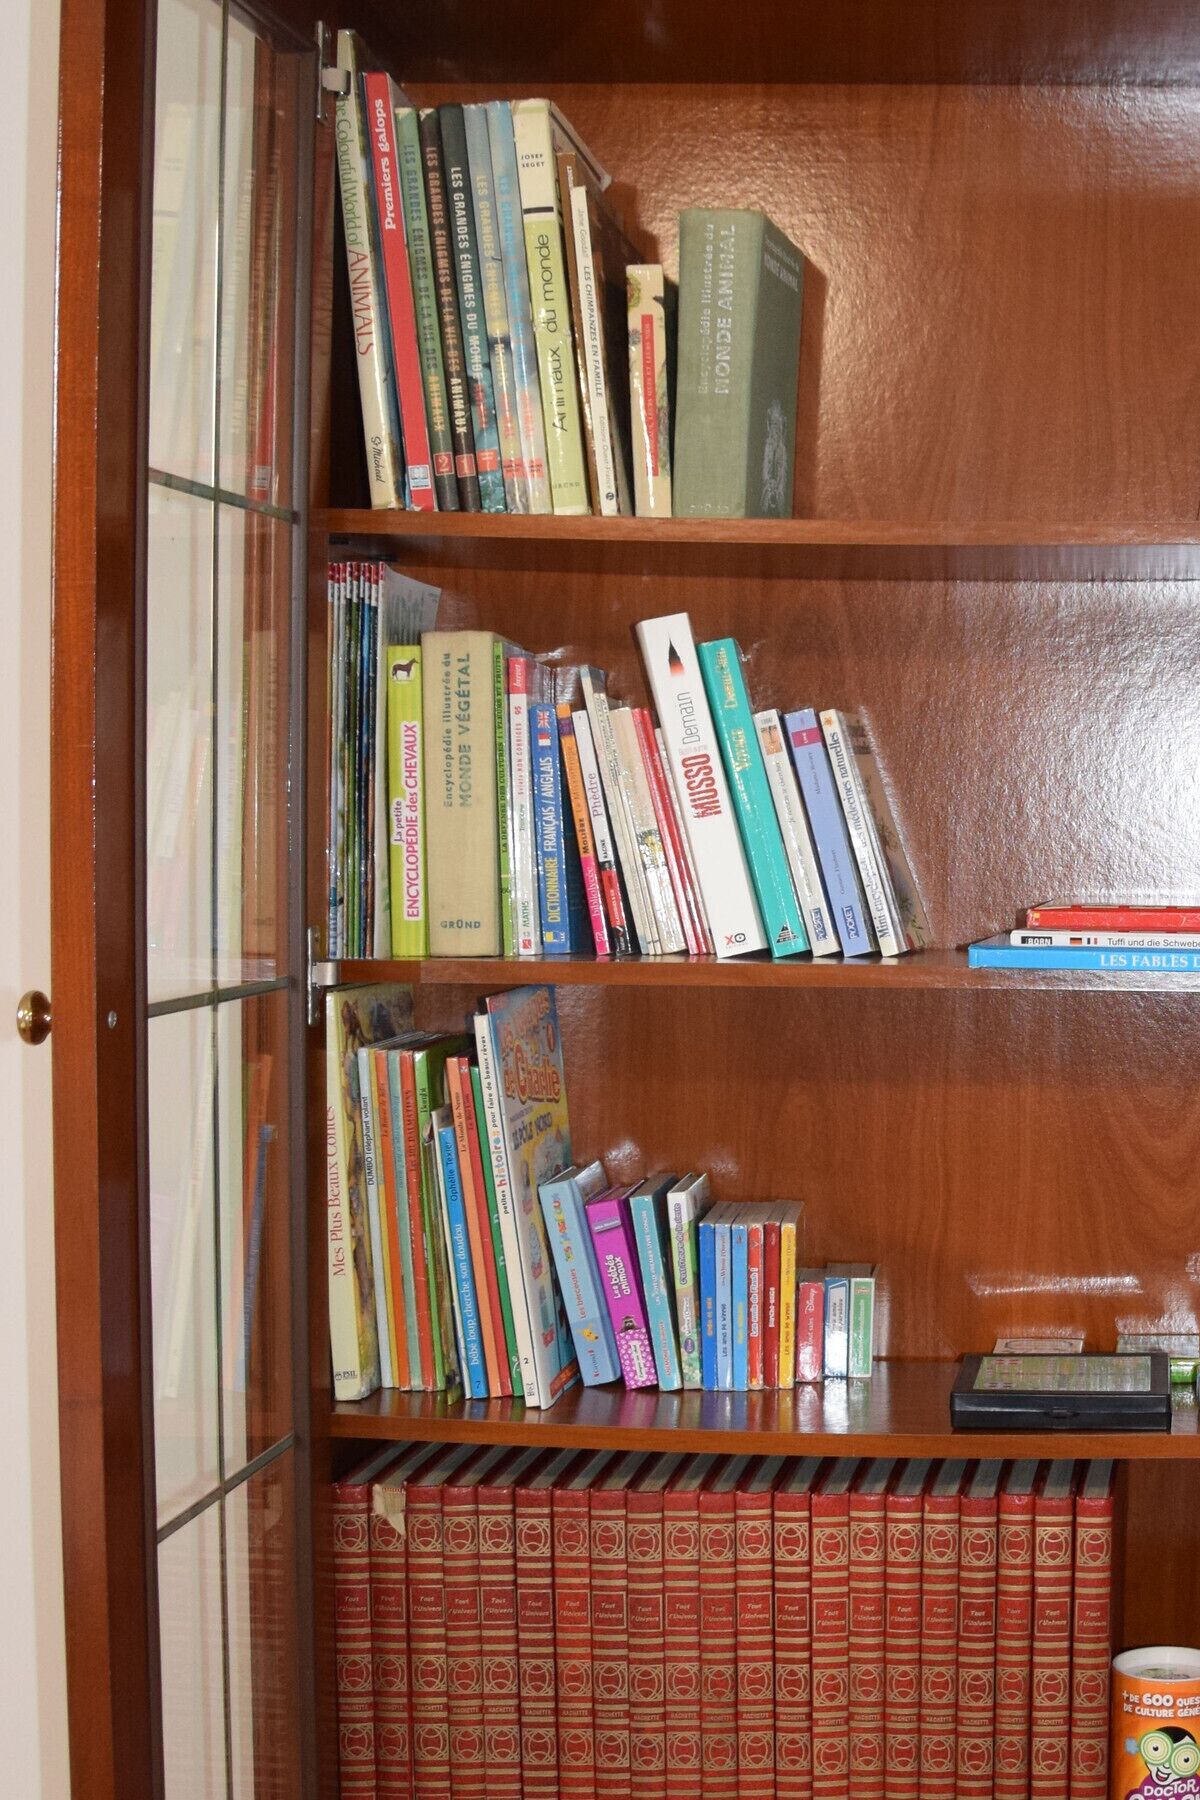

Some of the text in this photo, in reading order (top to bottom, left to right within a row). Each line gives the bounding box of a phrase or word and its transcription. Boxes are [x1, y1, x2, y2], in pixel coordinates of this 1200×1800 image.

[374, 98, 397, 230] Premiers galops
[449, 167, 464, 188] LES
[337, 120, 374, 356] Colourful World of ANIMALS
[452, 192, 471, 249] GRANDES
[704, 224, 715, 245] du
[536, 233, 554, 304] monde
[465, 313, 480, 330] DU
[545, 310, 558, 333] du
[582, 265, 592, 282] LES
[592, 356, 604, 398] FAMILLE
[714, 224, 736, 395] MONDE ANIMAL
[429, 375, 446, 432] ANIMAUX
[450, 378, 468, 434] ANIMAUX
[442, 652, 454, 808] Encyclopédie du
[453, 652, 472, 808] MONDE VÉGÉTAL
[515, 705, 522, 716] 95
[676, 691, 699, 745] Demain
[403, 723, 419, 813] des CHEVAUX
[828, 731, 852, 778] naturelles
[681, 752, 723, 820] MUSSO
[392, 799, 404, 829] petite
[588, 771, 609, 859] RACINE Phèdre
[539, 756, 561, 924] DICTIONNAIRE FRANÇAIS ANGLAIS
[840, 905, 860, 940] POCKET
[1107, 938, 1125, 946] Tuffi
[1128, 938, 1144, 947] und
[1147, 938, 1159, 947] die
[1101, 954, 1128, 967] LES
[1132, 954, 1188, 968] FABLES
[481, 1035, 489, 1057] rêves
[487, 1080, 493, 1092] de
[488, 1093, 496, 1110] faire
[362, 1096, 375, 1186] DUMBO volant
[404, 1089, 417, 1159] 101 DALMATIENS
[490, 1111, 498, 1128] pour
[492, 1130, 508, 1188] histoires
[327, 1105, 346, 1277] Mes Plus Beaux Contes
[502, 1189, 510, 1215] petites
[672, 1202, 683, 1224] sieste
[445, 1142, 481, 1366] bébé loup cherche son doudou Ophélie Texier
[605, 1253, 621, 1299] Les bébés
[615, 1256, 631, 1296] animaux
[569, 1268, 584, 1307] berceuses
[750, 1272, 758, 1337] Les amis de Flash
[805, 1288, 818, 1314] Disney
[523, 1357, 530, 1365] 2
[1123, 1704, 1133, 1713] DE
[1135, 1706, 1175, 1718] CULTURE
[1129, 1694, 1139, 1704] DE
[1142, 1693, 1174, 1707] 600
[1143, 1779, 1200, 1796] DOCTOR
